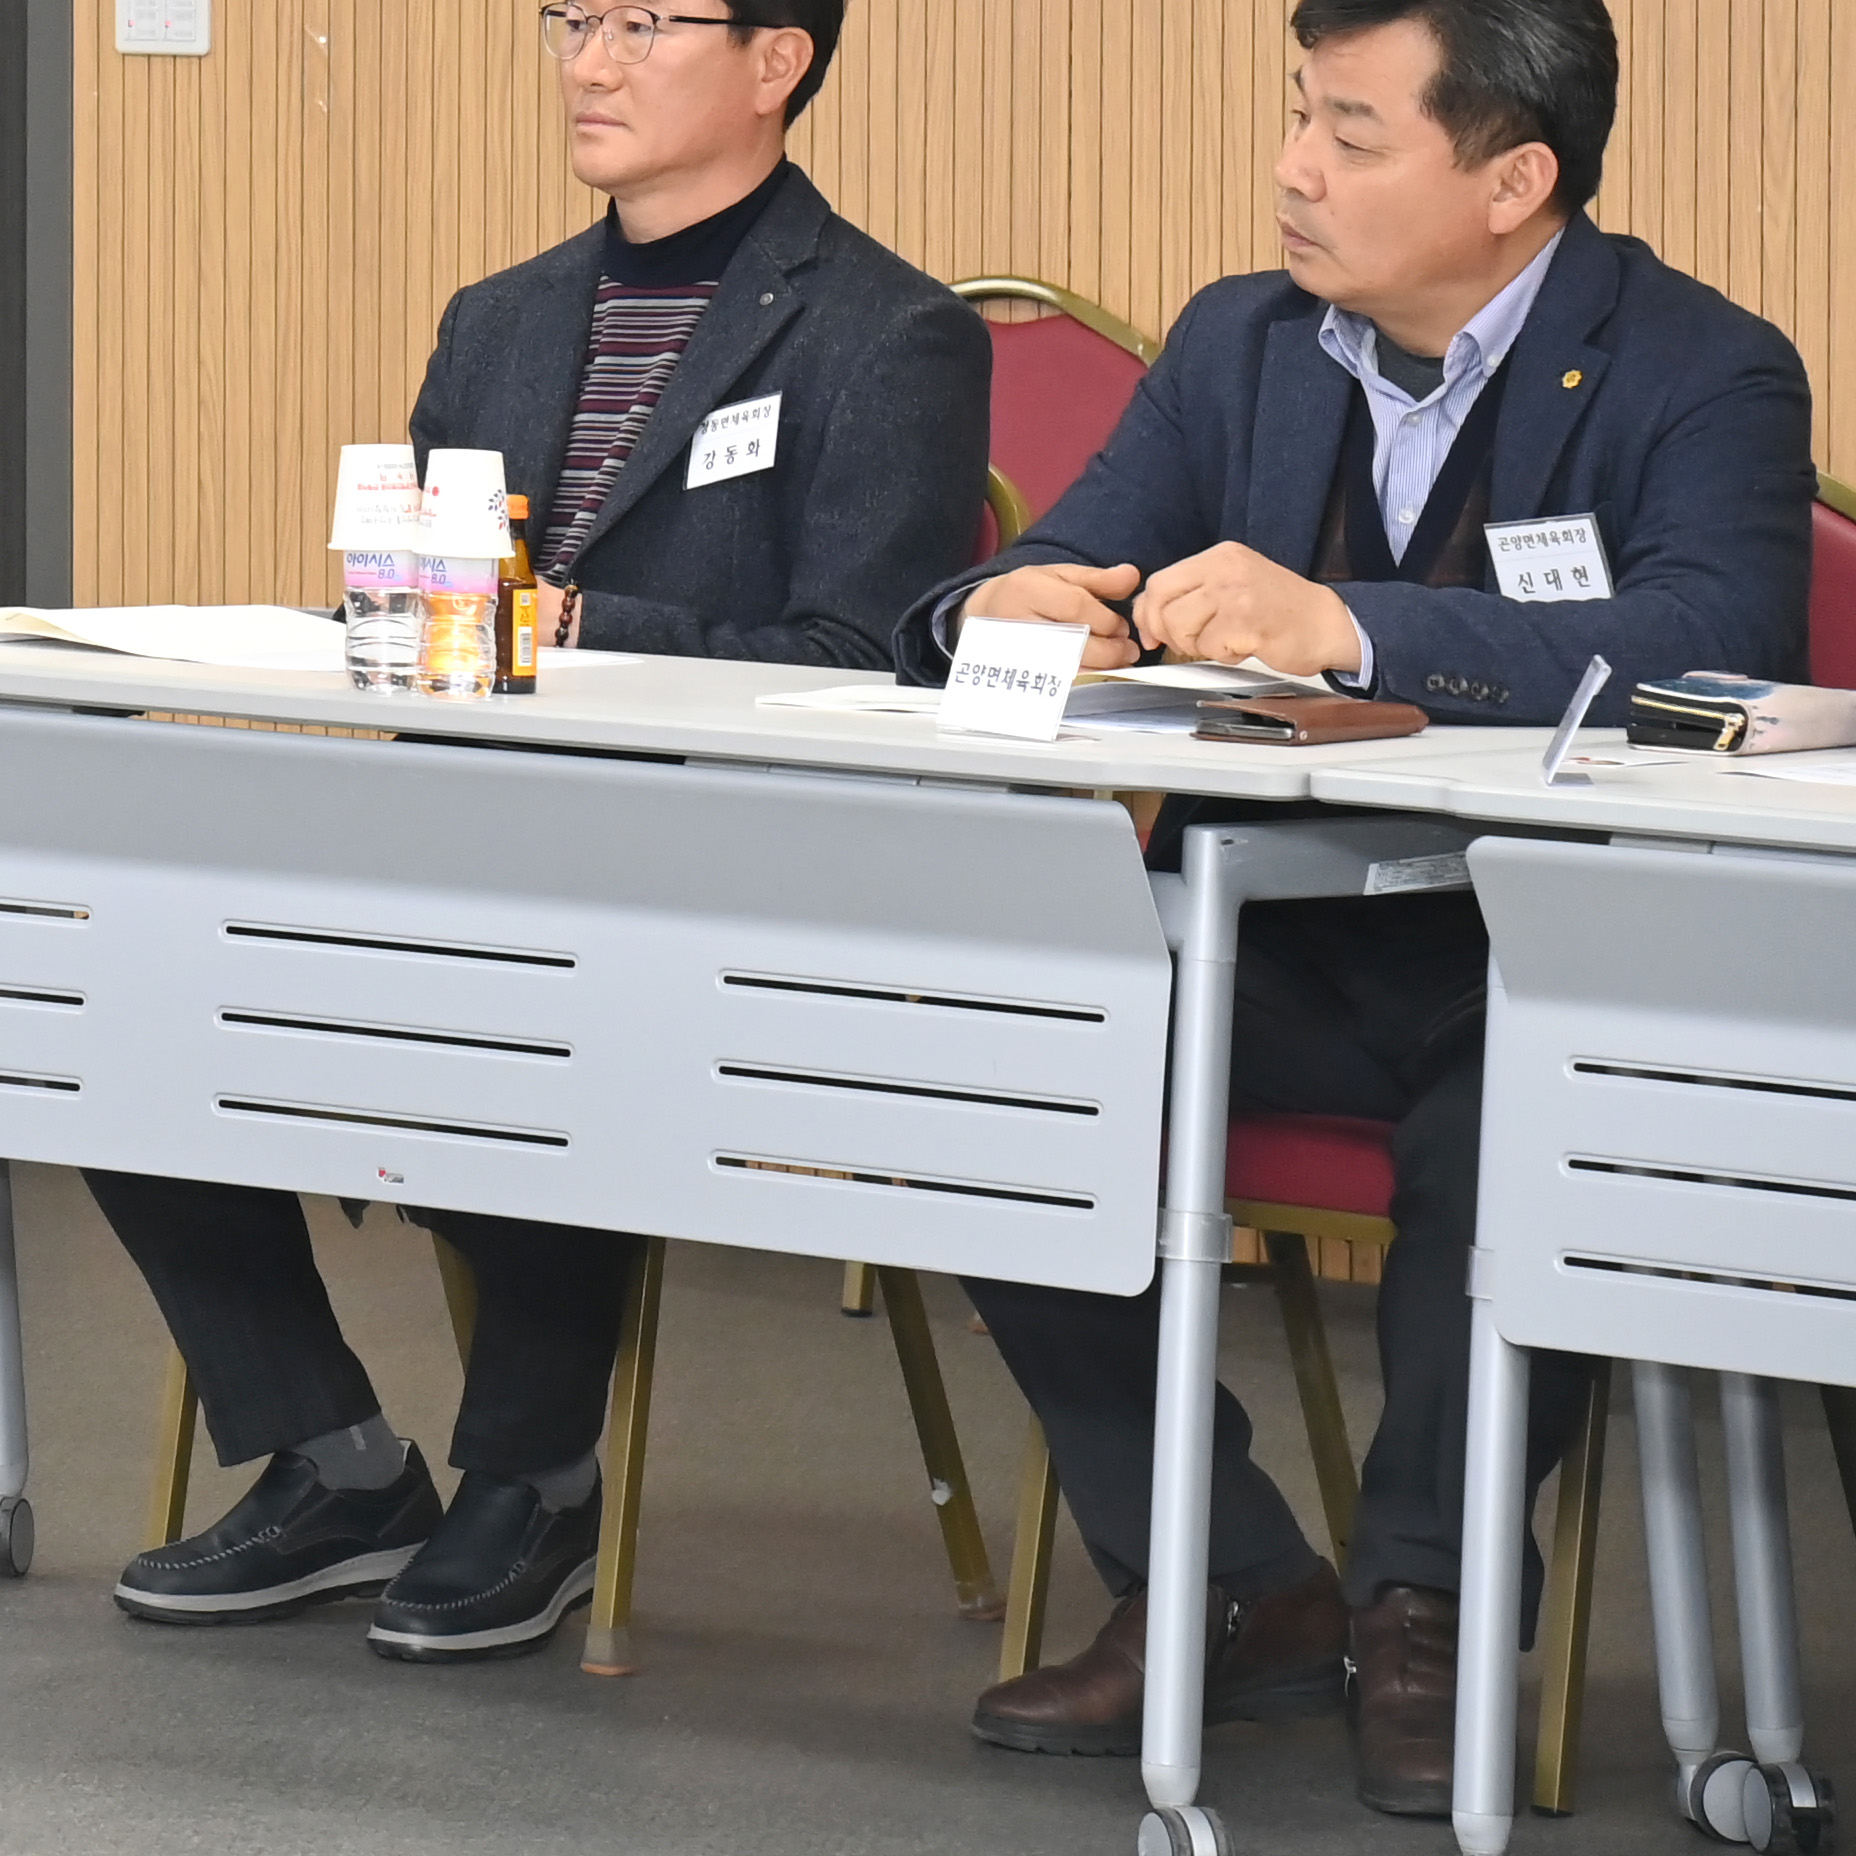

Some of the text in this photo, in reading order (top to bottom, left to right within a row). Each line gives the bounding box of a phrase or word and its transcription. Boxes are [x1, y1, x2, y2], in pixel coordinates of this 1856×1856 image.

[1497, 527, 1587, 552] 곤양면체육회장
[346, 553, 395, 568] 아이시스
[377, 568, 395, 579] 8.0
[431, 573, 447, 584] 8.0
[955, 662, 1062, 697] 곤양면체육회장
